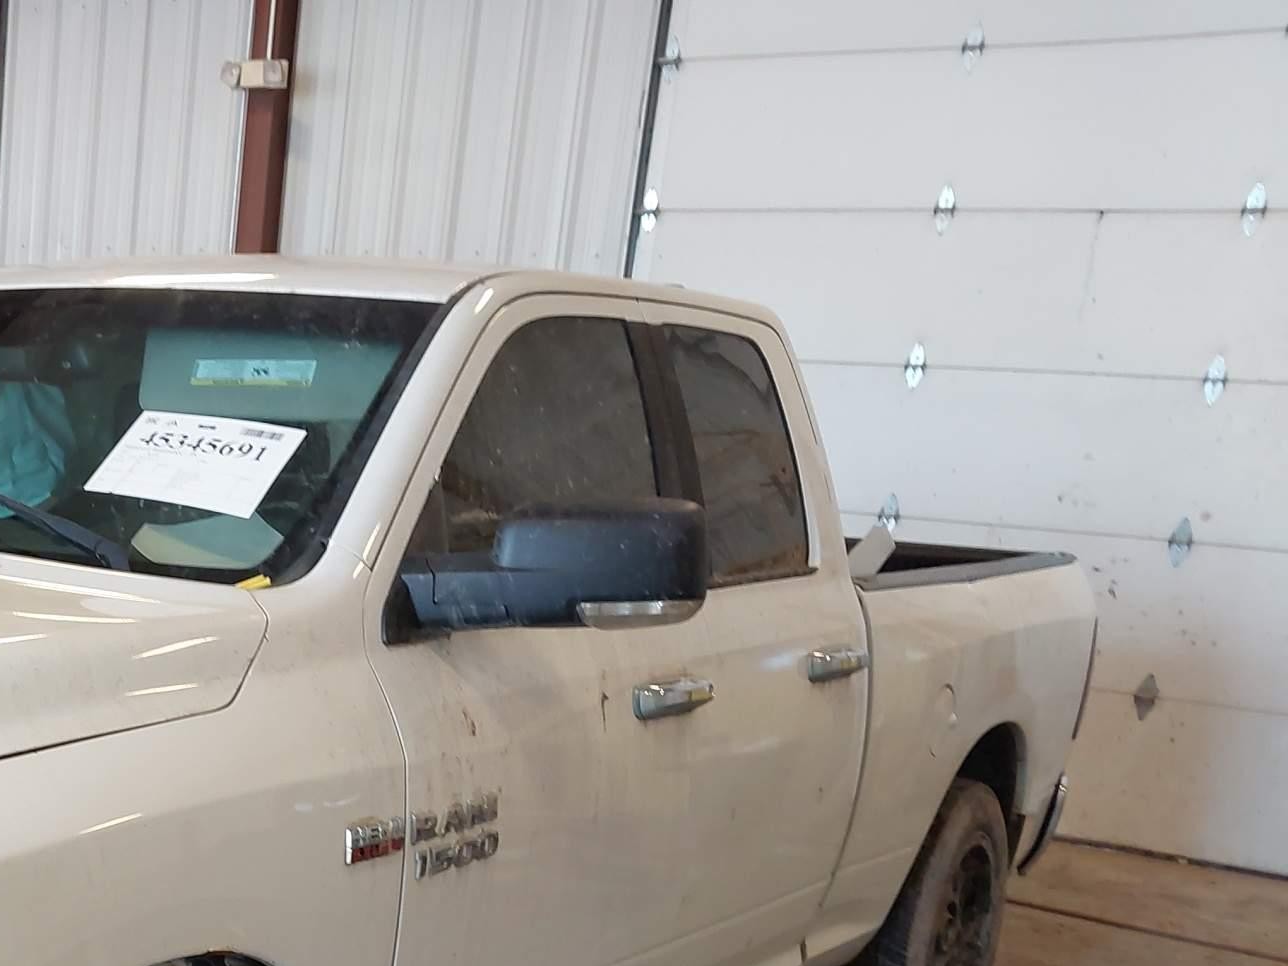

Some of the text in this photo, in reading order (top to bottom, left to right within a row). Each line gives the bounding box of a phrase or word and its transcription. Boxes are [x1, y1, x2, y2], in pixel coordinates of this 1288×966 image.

[140, 431, 268, 463] 45345691
[410, 791, 499, 845] RAM
[414, 830, 499, 880] 1500
